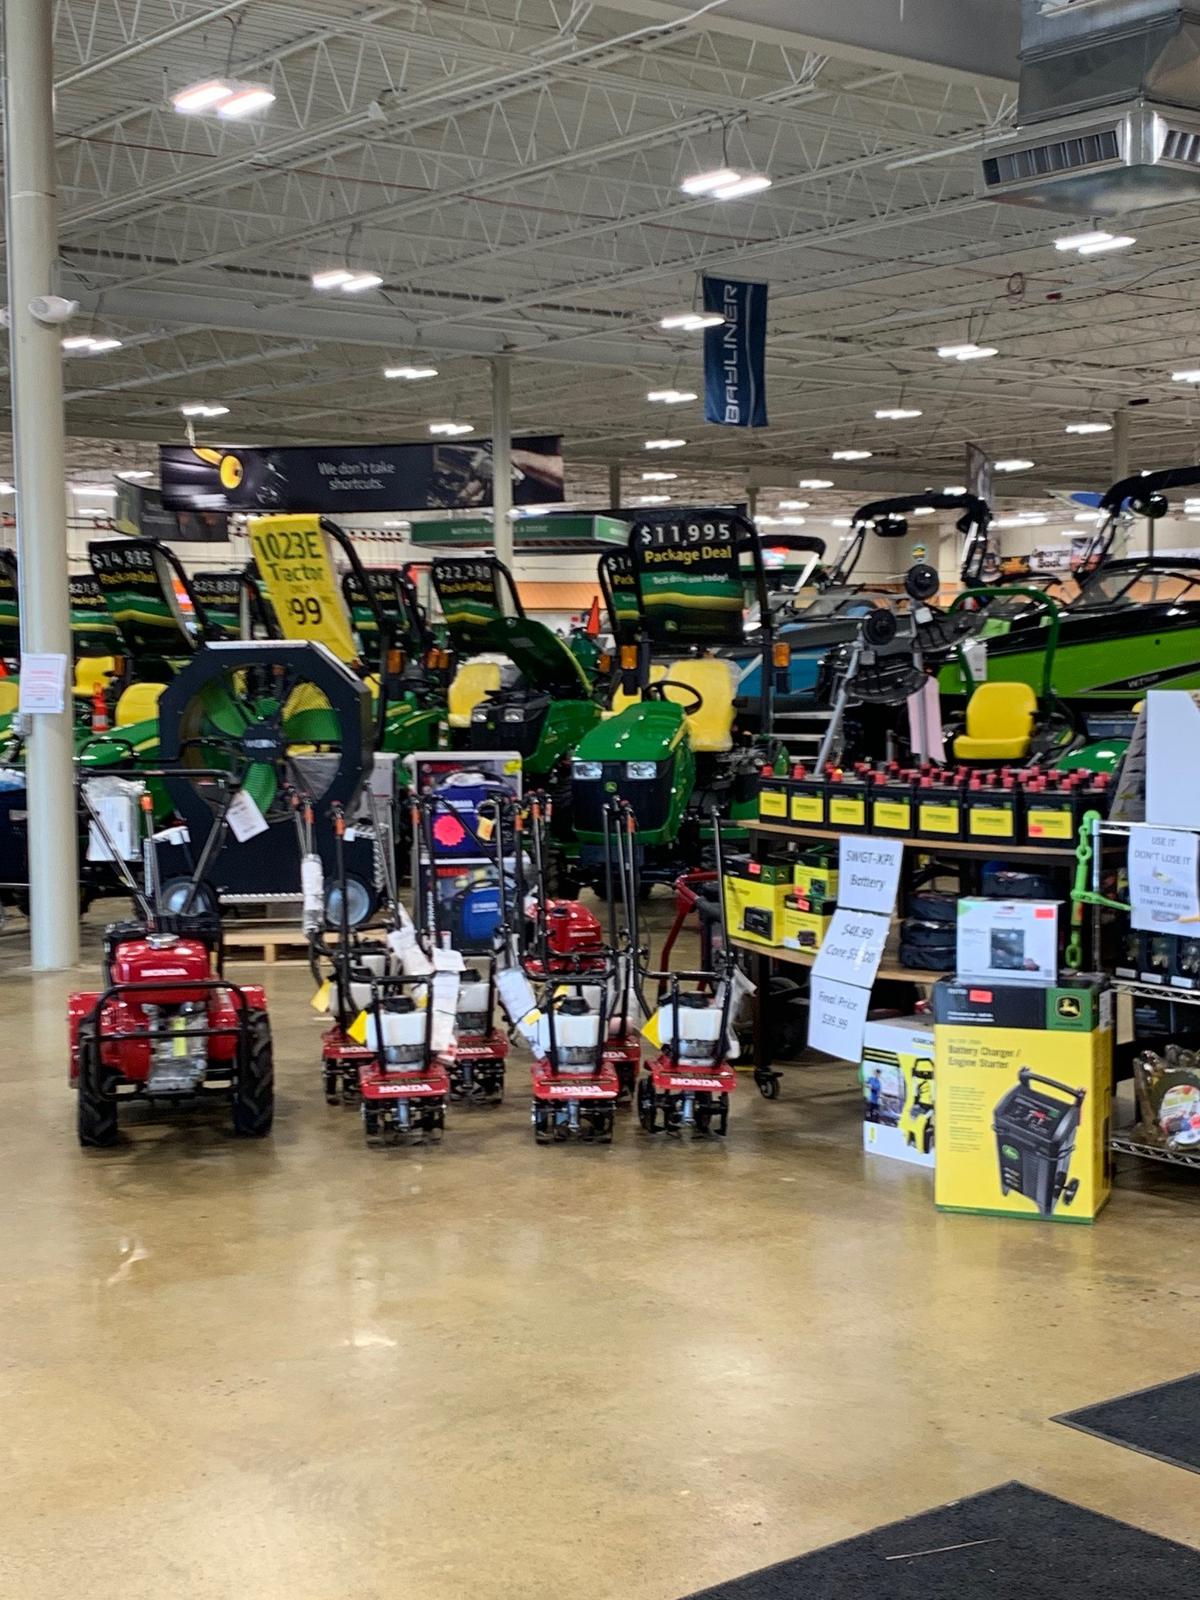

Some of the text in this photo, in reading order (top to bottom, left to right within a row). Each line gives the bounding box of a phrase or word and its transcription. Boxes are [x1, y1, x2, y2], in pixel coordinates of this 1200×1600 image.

[724, 284, 740, 424] BAYLINER
[317, 460, 396, 475] We don't take
[641, 524, 731, 546] $11,995
[254, 531, 322, 561] 1023E
[644, 545, 732, 565] Package Deal
[1151, 837, 1177, 848] USE IT
[1134, 849, 1192, 866] DON'T LOSE IT
[850, 874, 886, 892] Battery
[1162, 887, 1189, 899] DOWN
[949, 1045, 978, 1057] Battery
[980, 1047, 1014, 1058] Charger
[948, 1057, 1009, 1069] Engine Starter
[378, 1084, 432, 1094] HONDA
[550, 1085, 603, 1094] HONDA
[670, 1078, 723, 1088] HONDA
